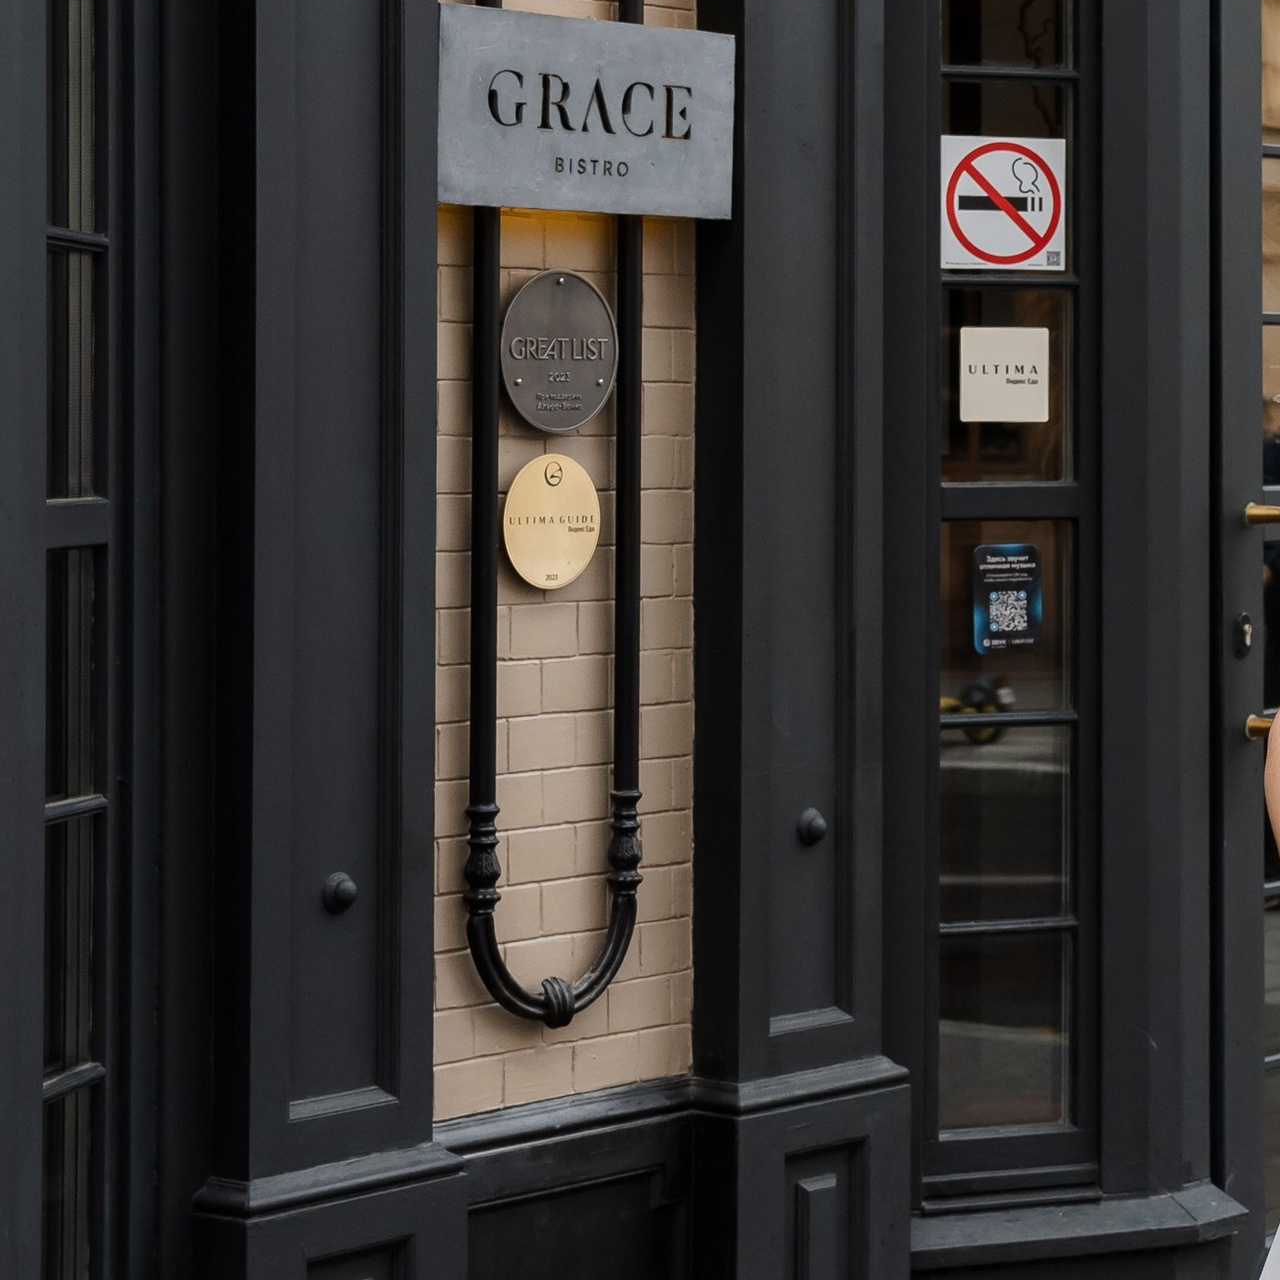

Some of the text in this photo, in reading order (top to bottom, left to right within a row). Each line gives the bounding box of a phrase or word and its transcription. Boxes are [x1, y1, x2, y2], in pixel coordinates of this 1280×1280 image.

[487, 69, 693, 141] GRACE
[555, 157, 630, 178] BISTRO
[510, 337, 609, 360] GREAT LIST
[548, 371, 571, 382] 2023
[968, 364, 1039, 375] ULTIMA
[509, 515, 595, 526] ULTIMA GUIDE
